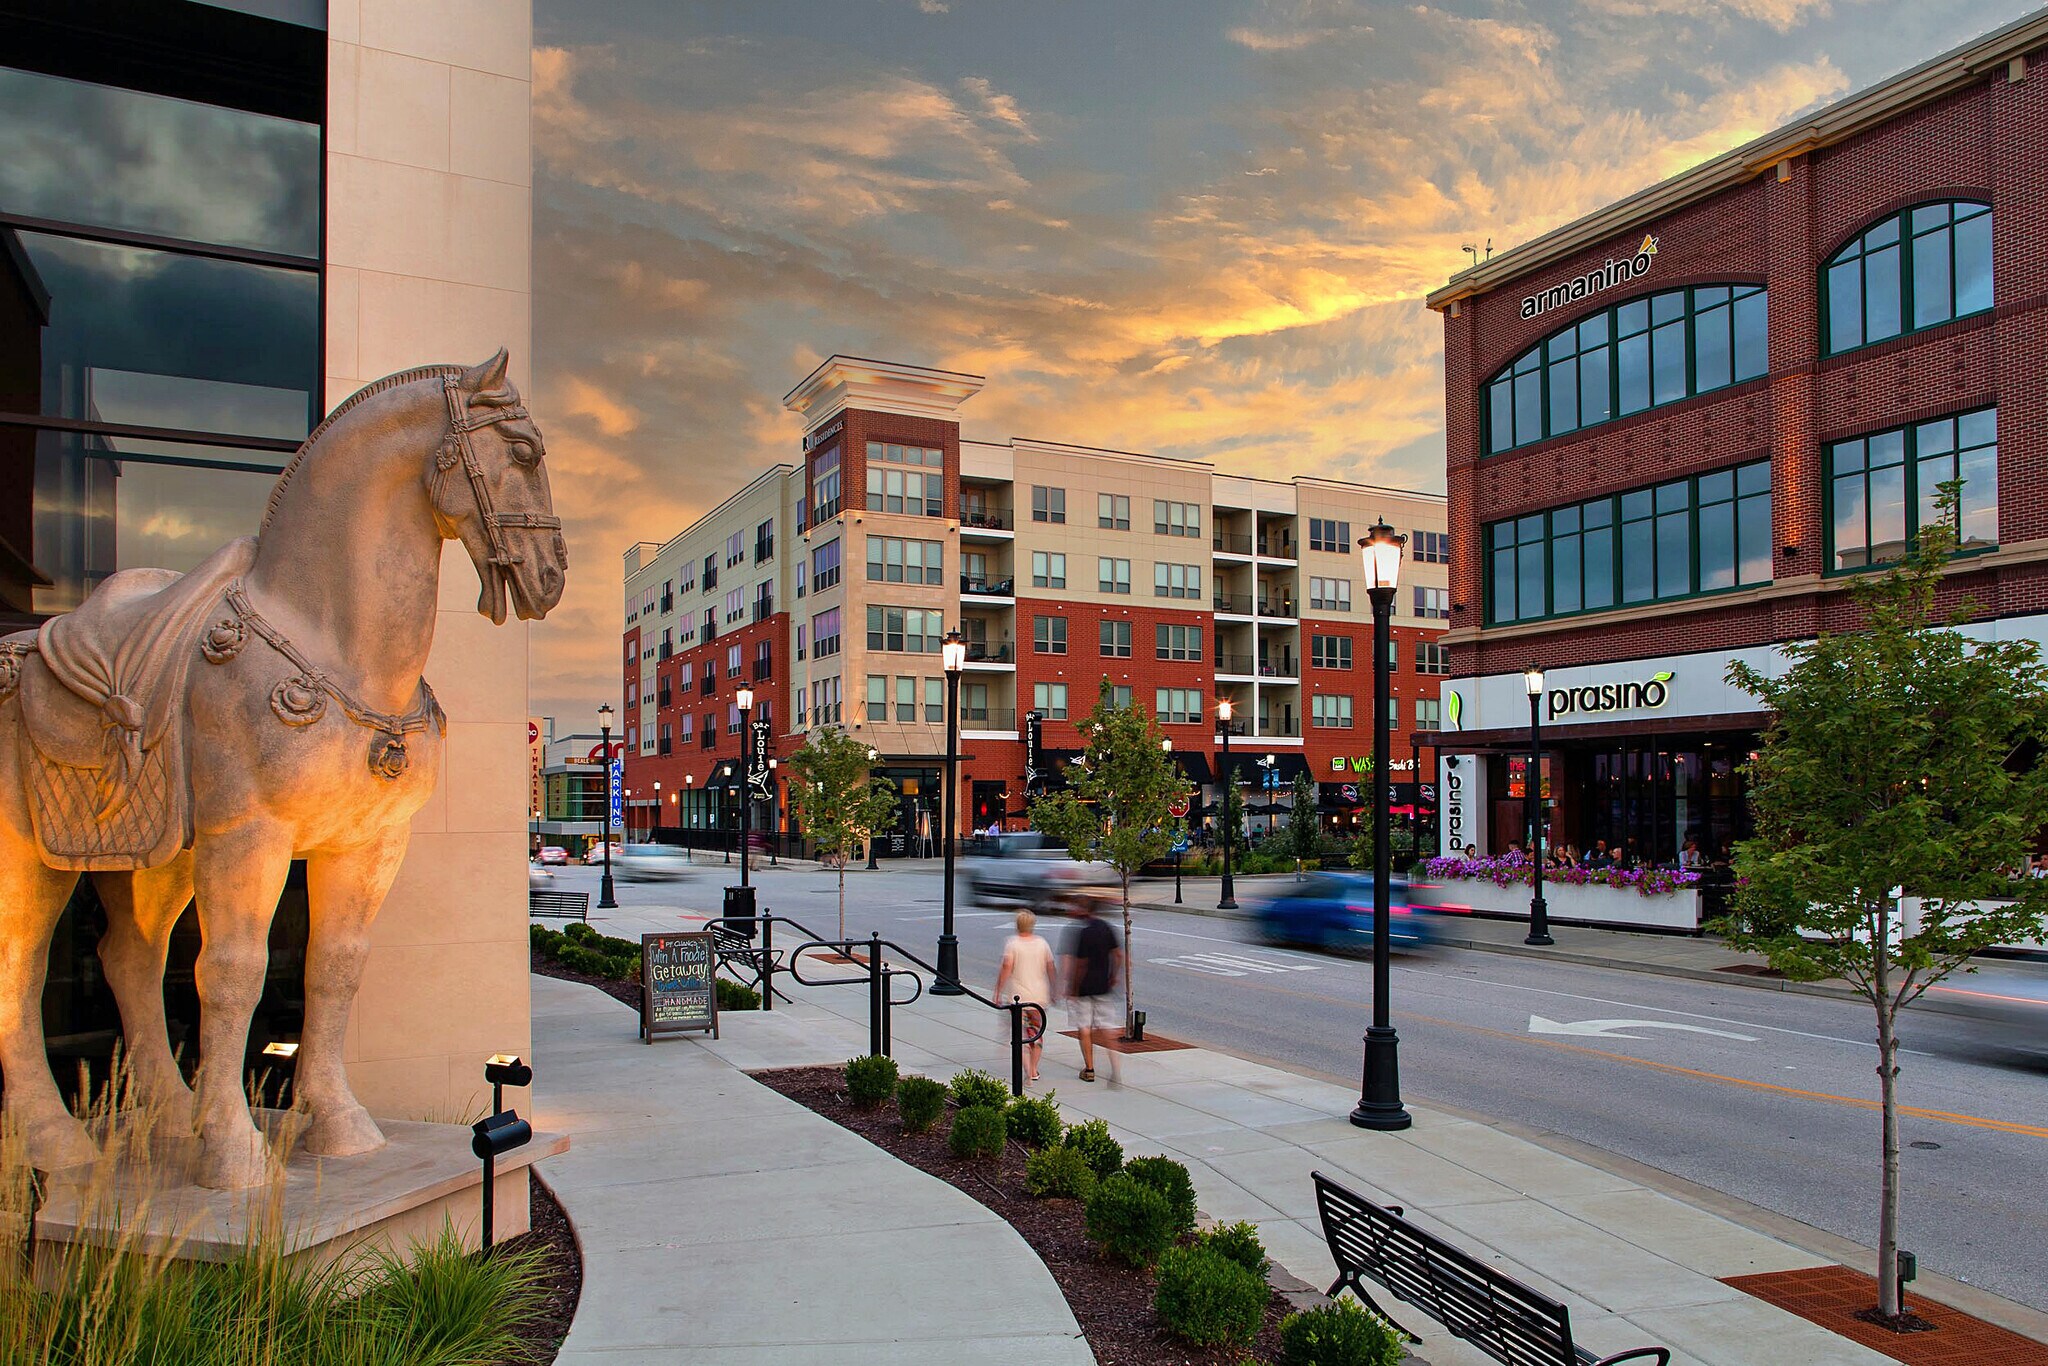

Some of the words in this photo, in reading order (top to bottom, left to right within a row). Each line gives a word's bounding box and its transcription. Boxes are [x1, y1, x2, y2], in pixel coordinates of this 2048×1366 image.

[1521, 252, 1652, 320] armanino
[1548, 681, 1667, 721] prasino
[752, 721, 770, 730] Bar
[756, 730, 766, 771] Louie
[1350, 756, 1375, 773] WAS
[612, 759, 621, 826] PARKING
[1448, 775, 1466, 851] prasino
[651, 949, 668, 964] Win
[671, 948, 678, 963] A
[680, 946, 706, 963] Foodie
[652, 963, 708, 981] Getaway
[664, 996, 708, 1006] HANDMADE
